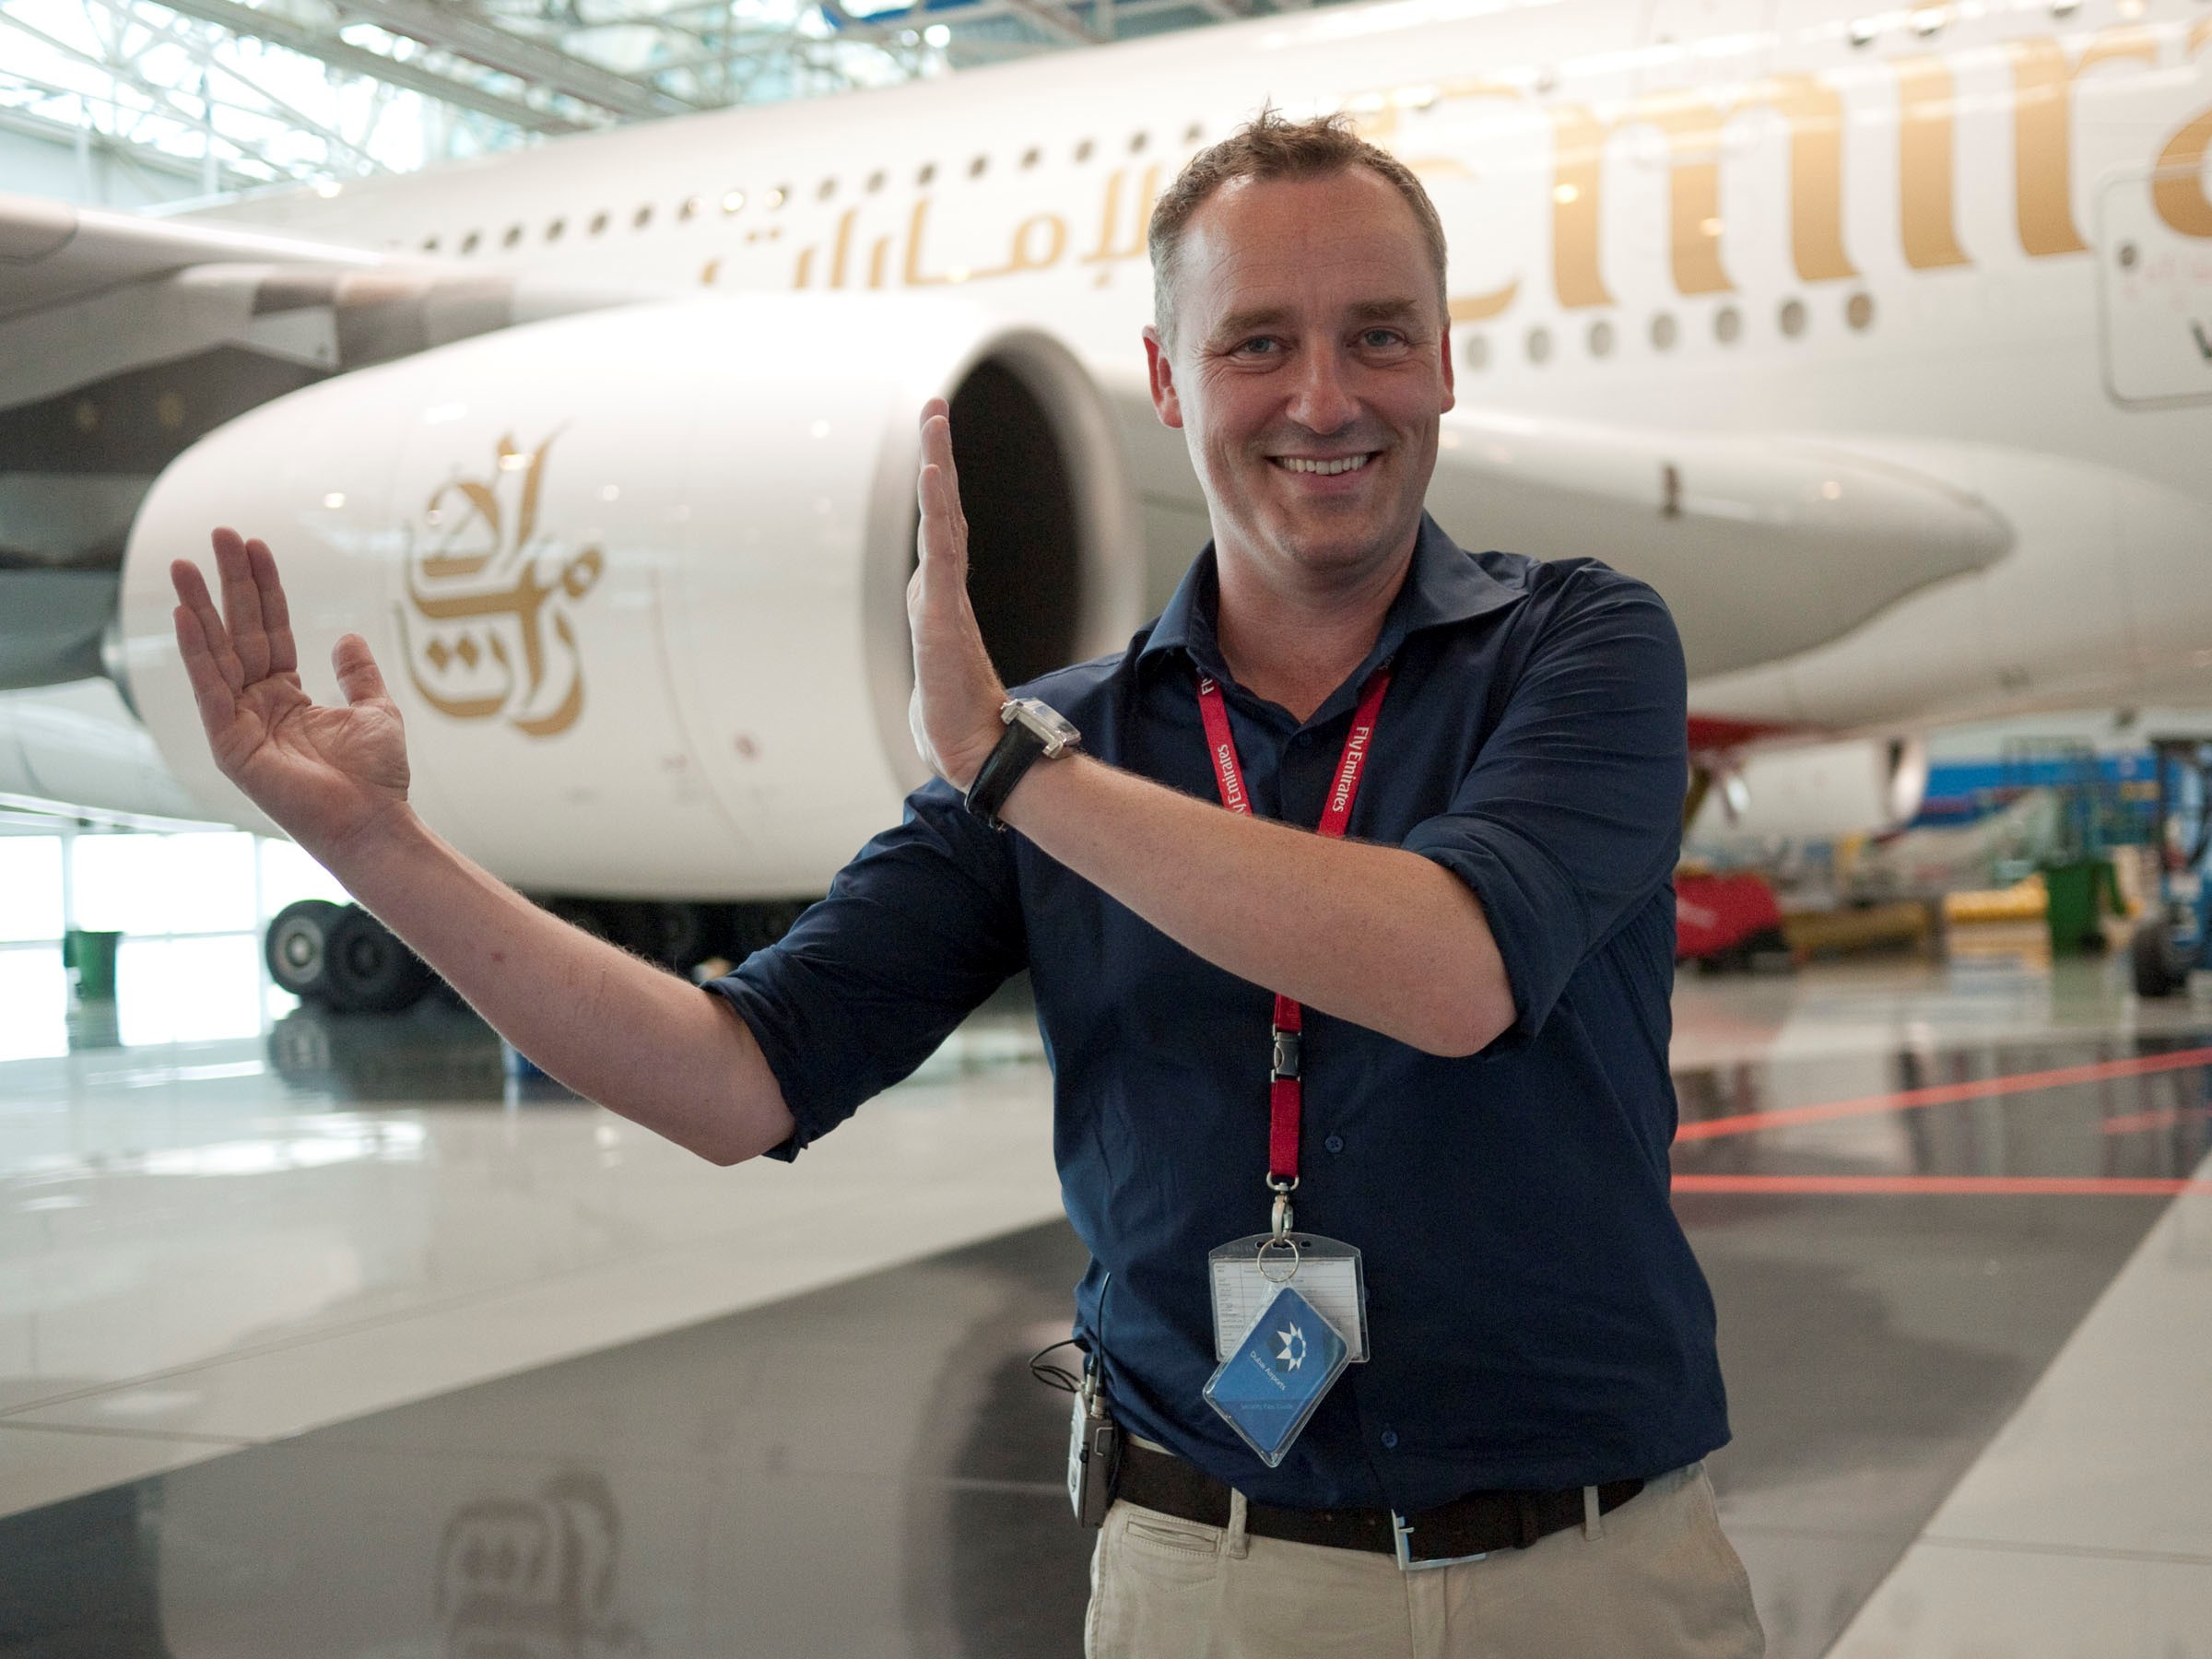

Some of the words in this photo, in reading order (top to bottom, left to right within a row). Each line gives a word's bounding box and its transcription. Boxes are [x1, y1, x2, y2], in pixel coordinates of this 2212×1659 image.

[1350, 726, 1370, 751] Fly
[1218, 744, 1242, 805] Emirates
[1332, 751, 1363, 813] Emirates
[1250, 1350, 1266, 1370] Dubai
[1265, 1368, 1287, 1391] Airports
